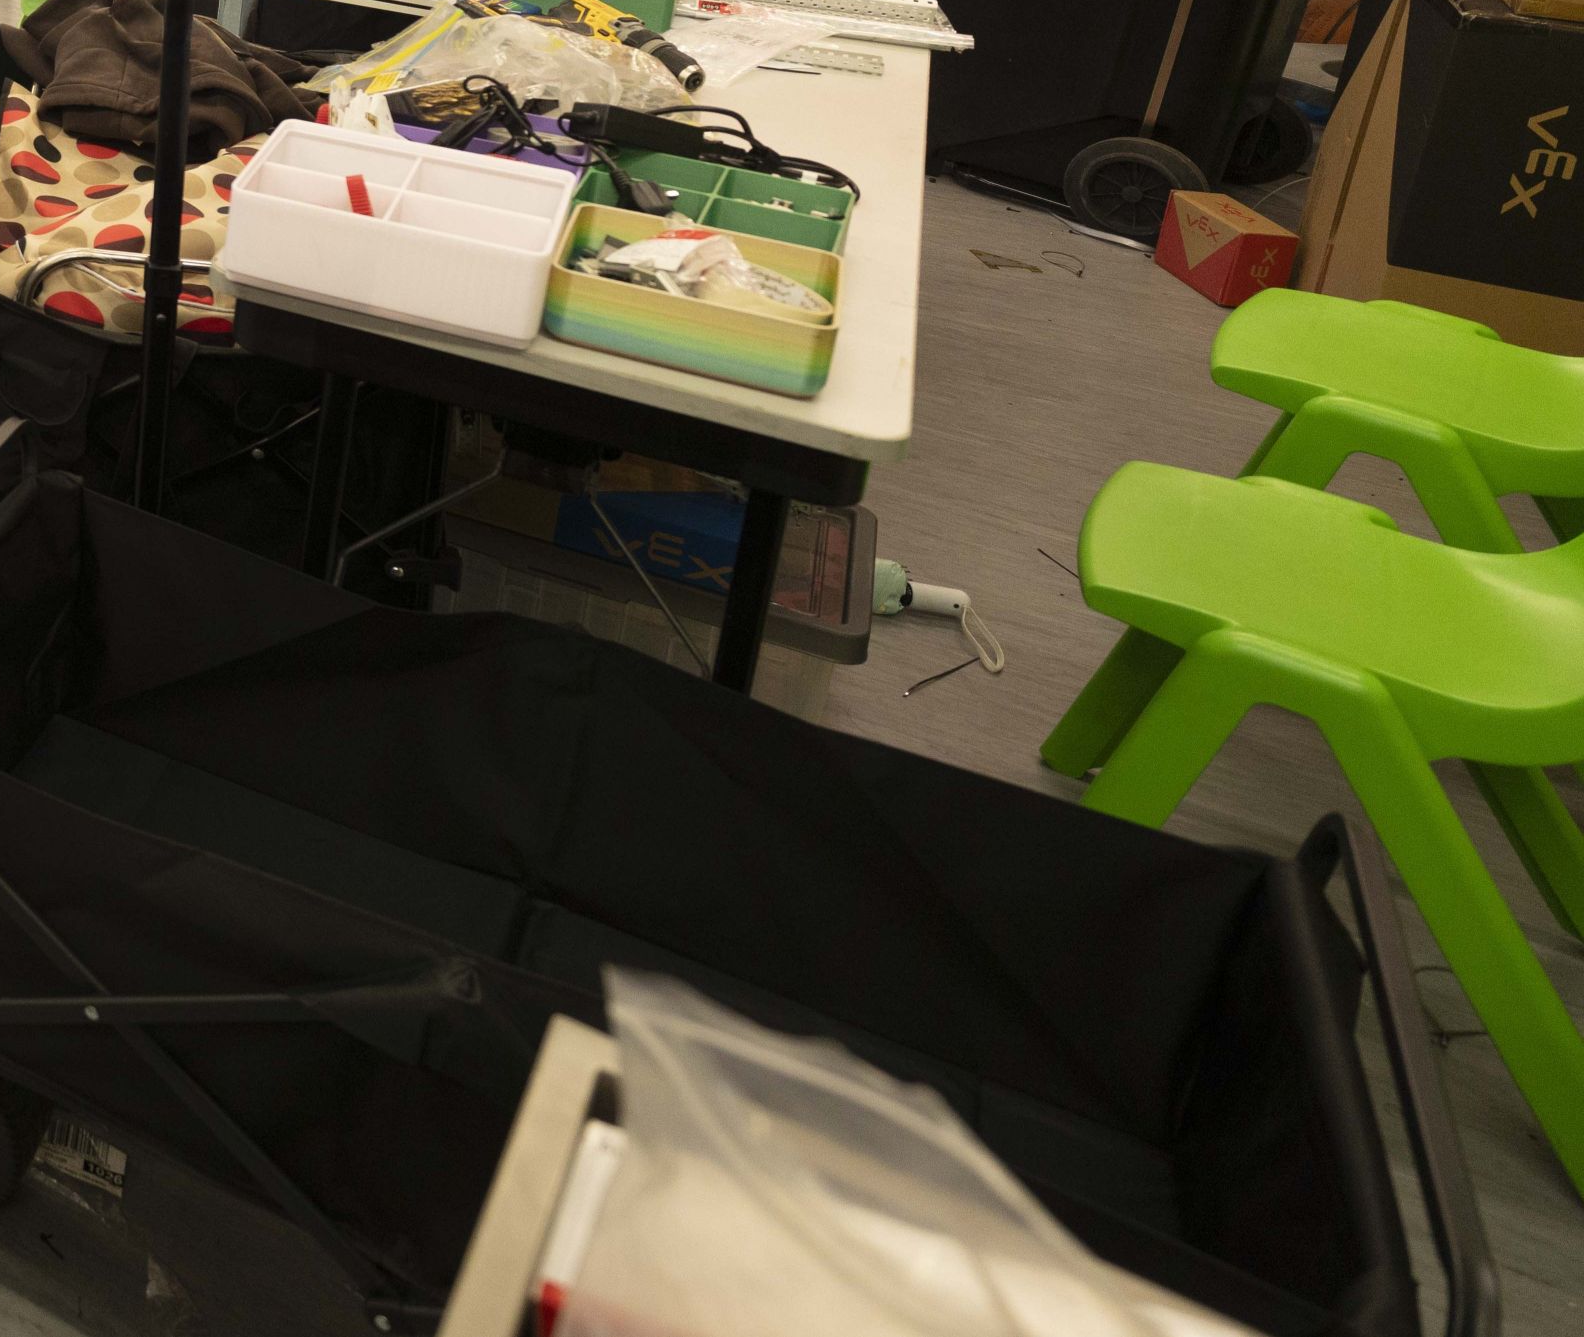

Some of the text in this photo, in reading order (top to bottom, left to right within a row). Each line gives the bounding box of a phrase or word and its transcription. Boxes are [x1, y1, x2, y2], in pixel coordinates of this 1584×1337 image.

[1500, 105, 1578, 218] VEX
[1185, 212, 1220, 243] VEX
[593, 527, 733, 590] VEX
